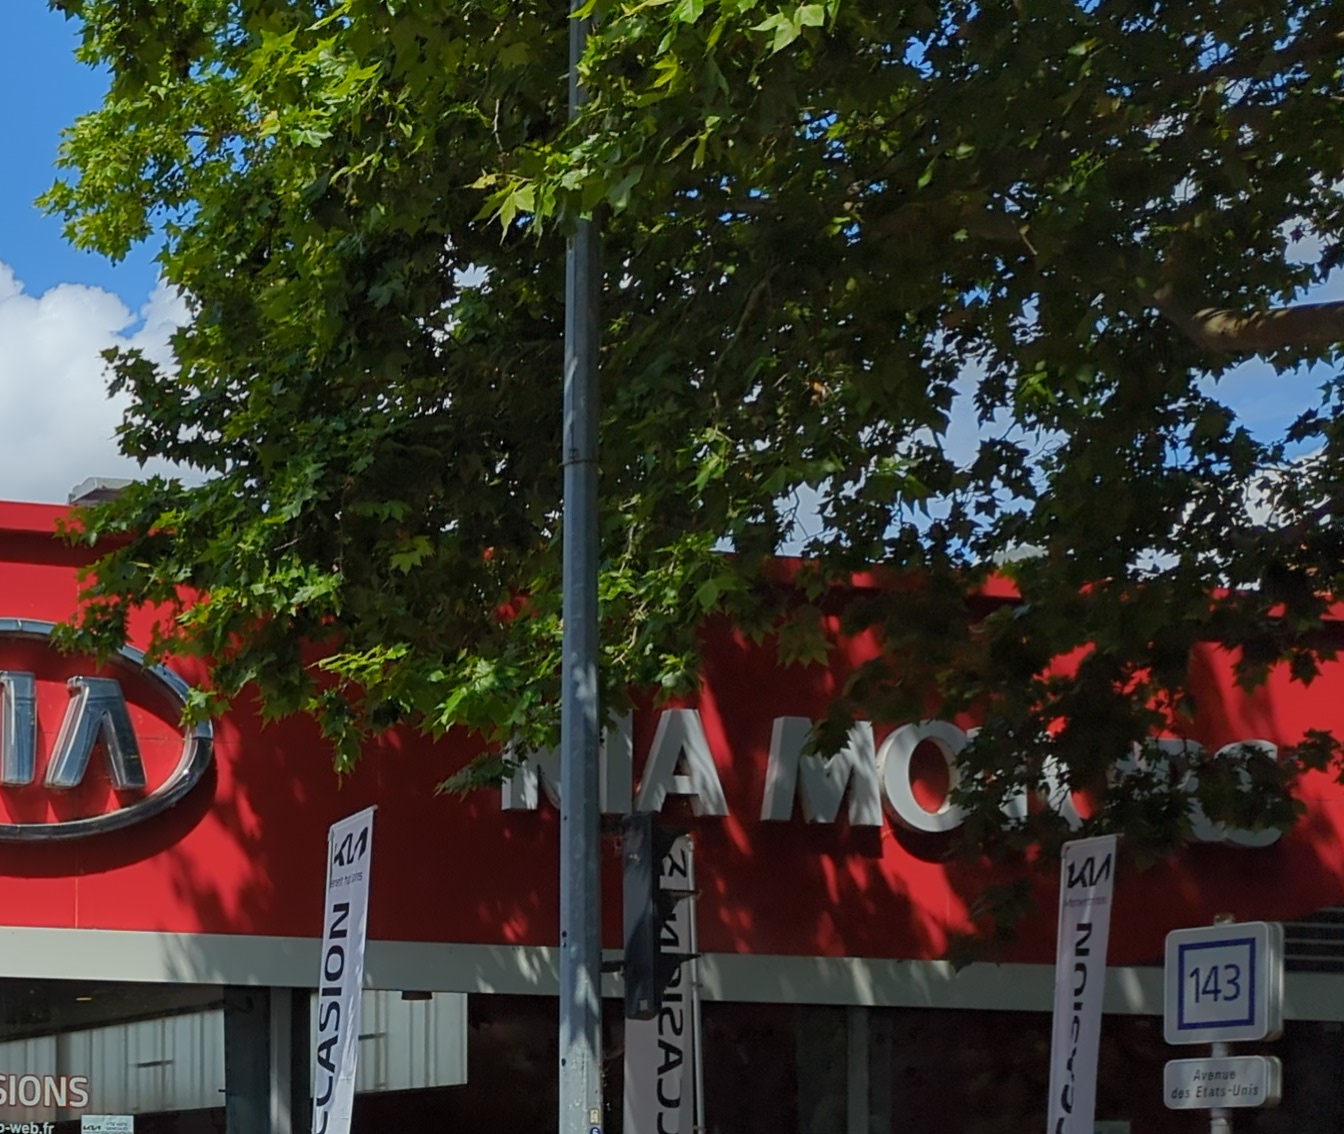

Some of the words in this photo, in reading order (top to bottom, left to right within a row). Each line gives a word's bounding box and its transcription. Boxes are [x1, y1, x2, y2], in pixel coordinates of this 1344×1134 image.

[1189, 963, 1241, 1003] 143
[1193, 1069, 1236, 1081] Avenue
[1171, 1087, 1191, 1099] des
[1195, 1084, 1259, 1098] Etats-Unis
